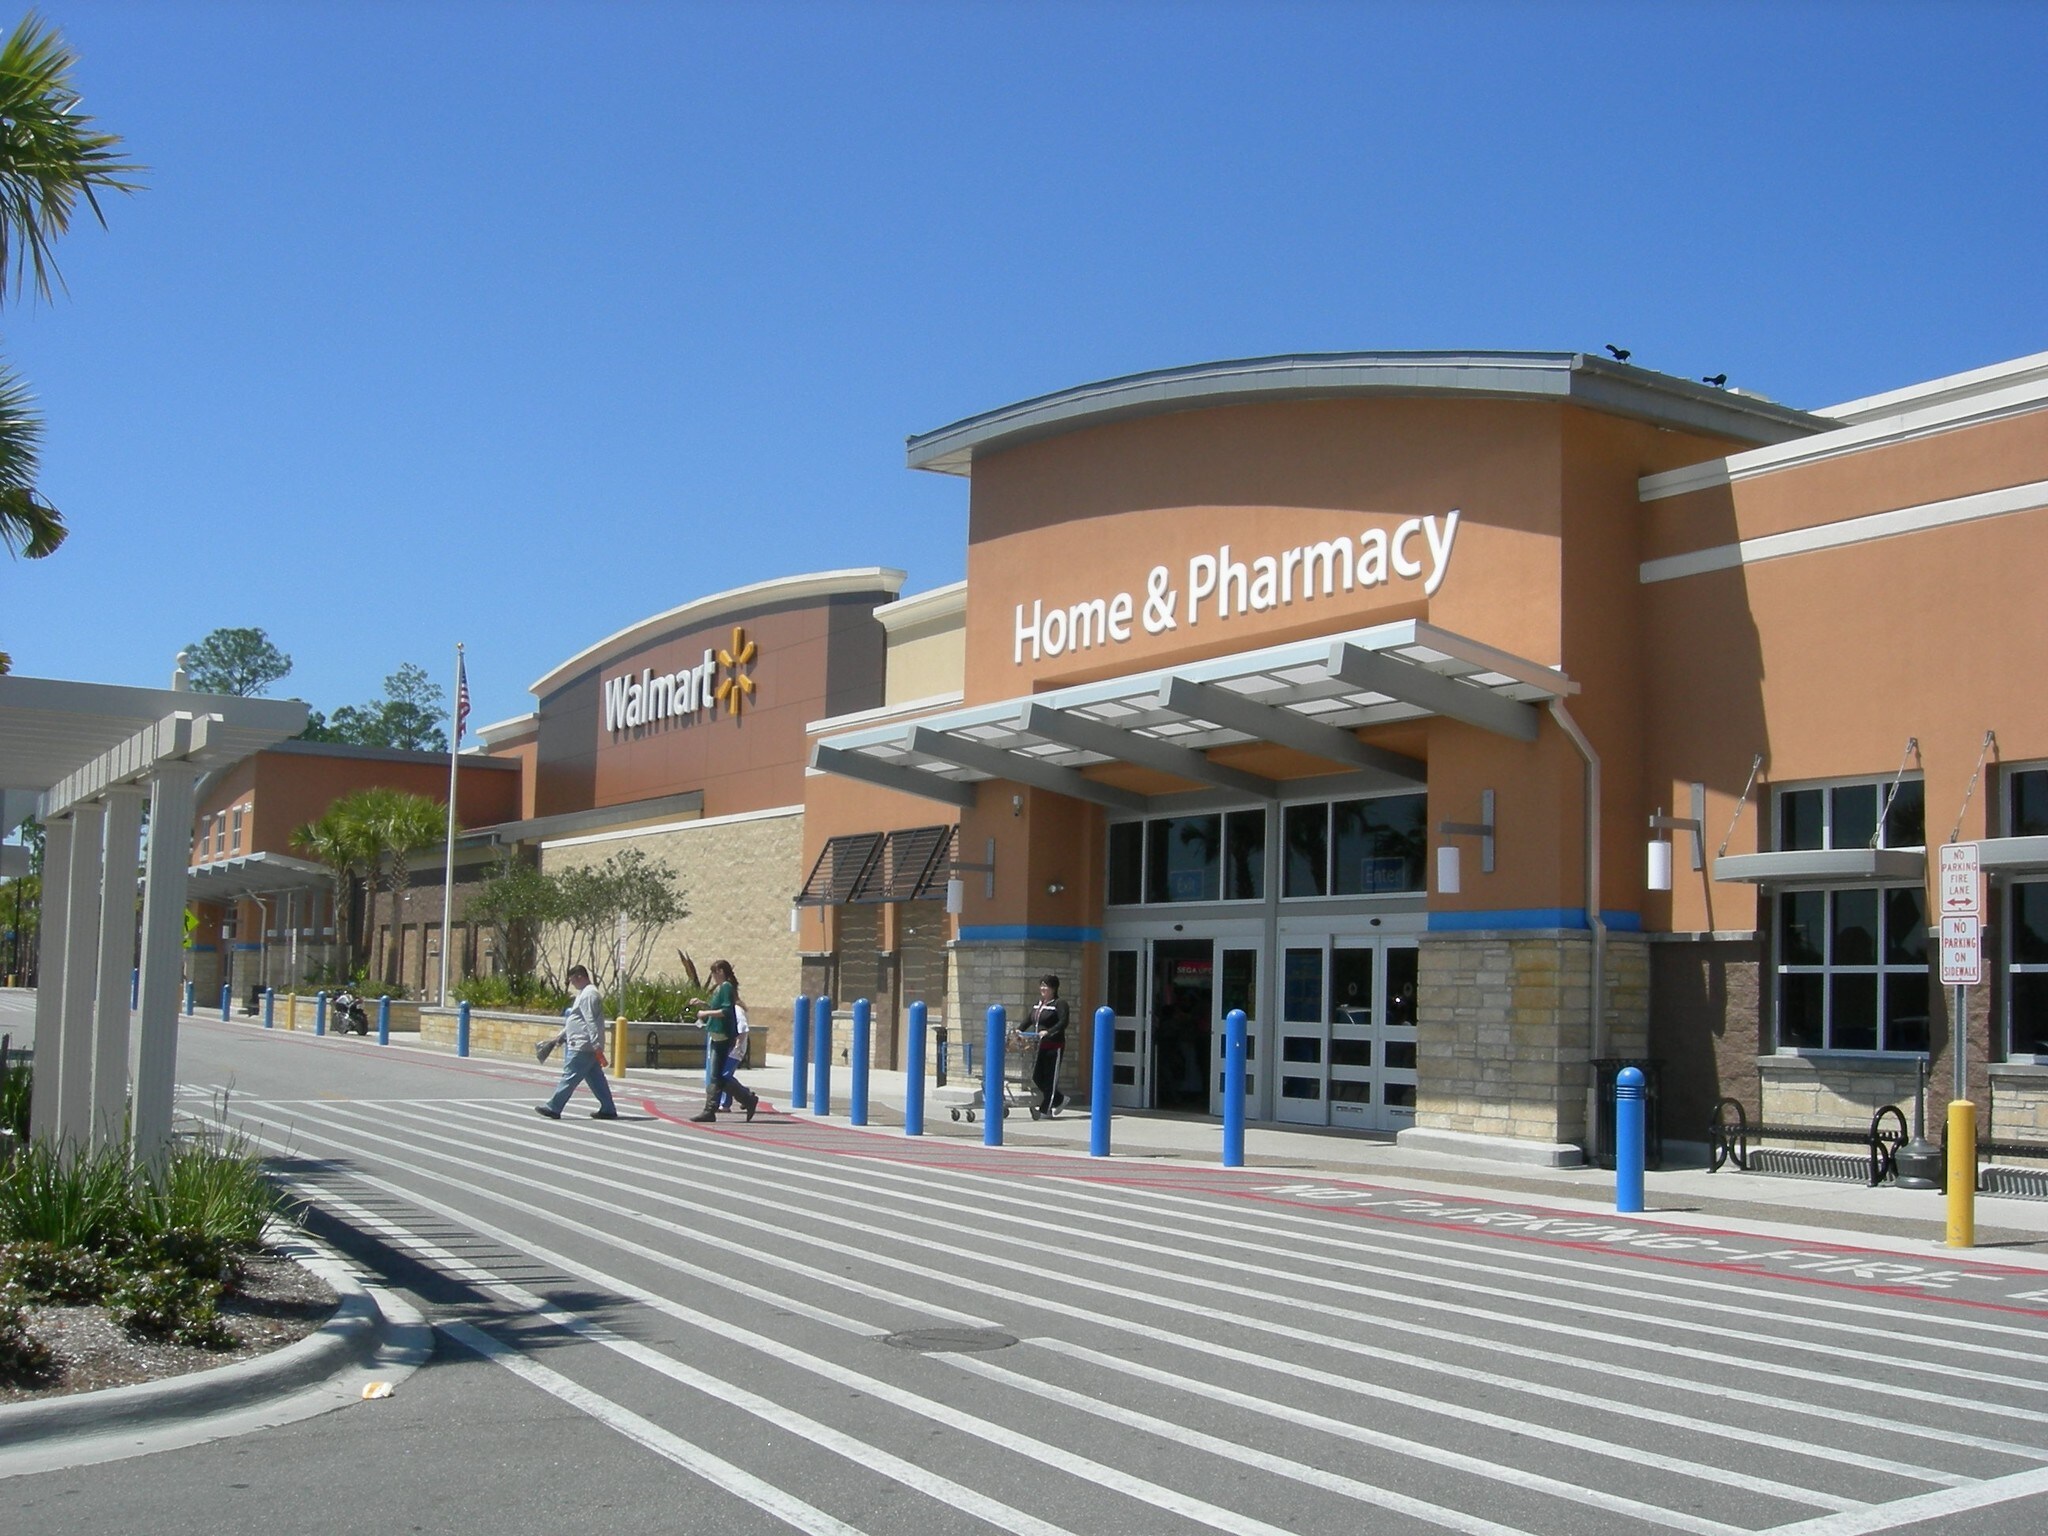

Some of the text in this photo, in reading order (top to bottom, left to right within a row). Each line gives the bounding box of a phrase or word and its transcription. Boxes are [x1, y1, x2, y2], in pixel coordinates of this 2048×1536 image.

[1014, 507, 1461, 664] Home & Pharmacy
[605, 648, 716, 732] Walmart
[1953, 850, 1965, 860] NO
[1942, 863, 1977, 872] PARKING
[1950, 874, 1968, 883] FIRE
[1949, 886, 1970, 895] LANE
[1953, 922, 1966, 933] NO
[1944, 938, 1976, 948] PARKING
[1954, 952, 1966, 963] ON
[1944, 966, 1976, 977] SIDEWALK
[1250, 1184, 1372, 1199] NO
